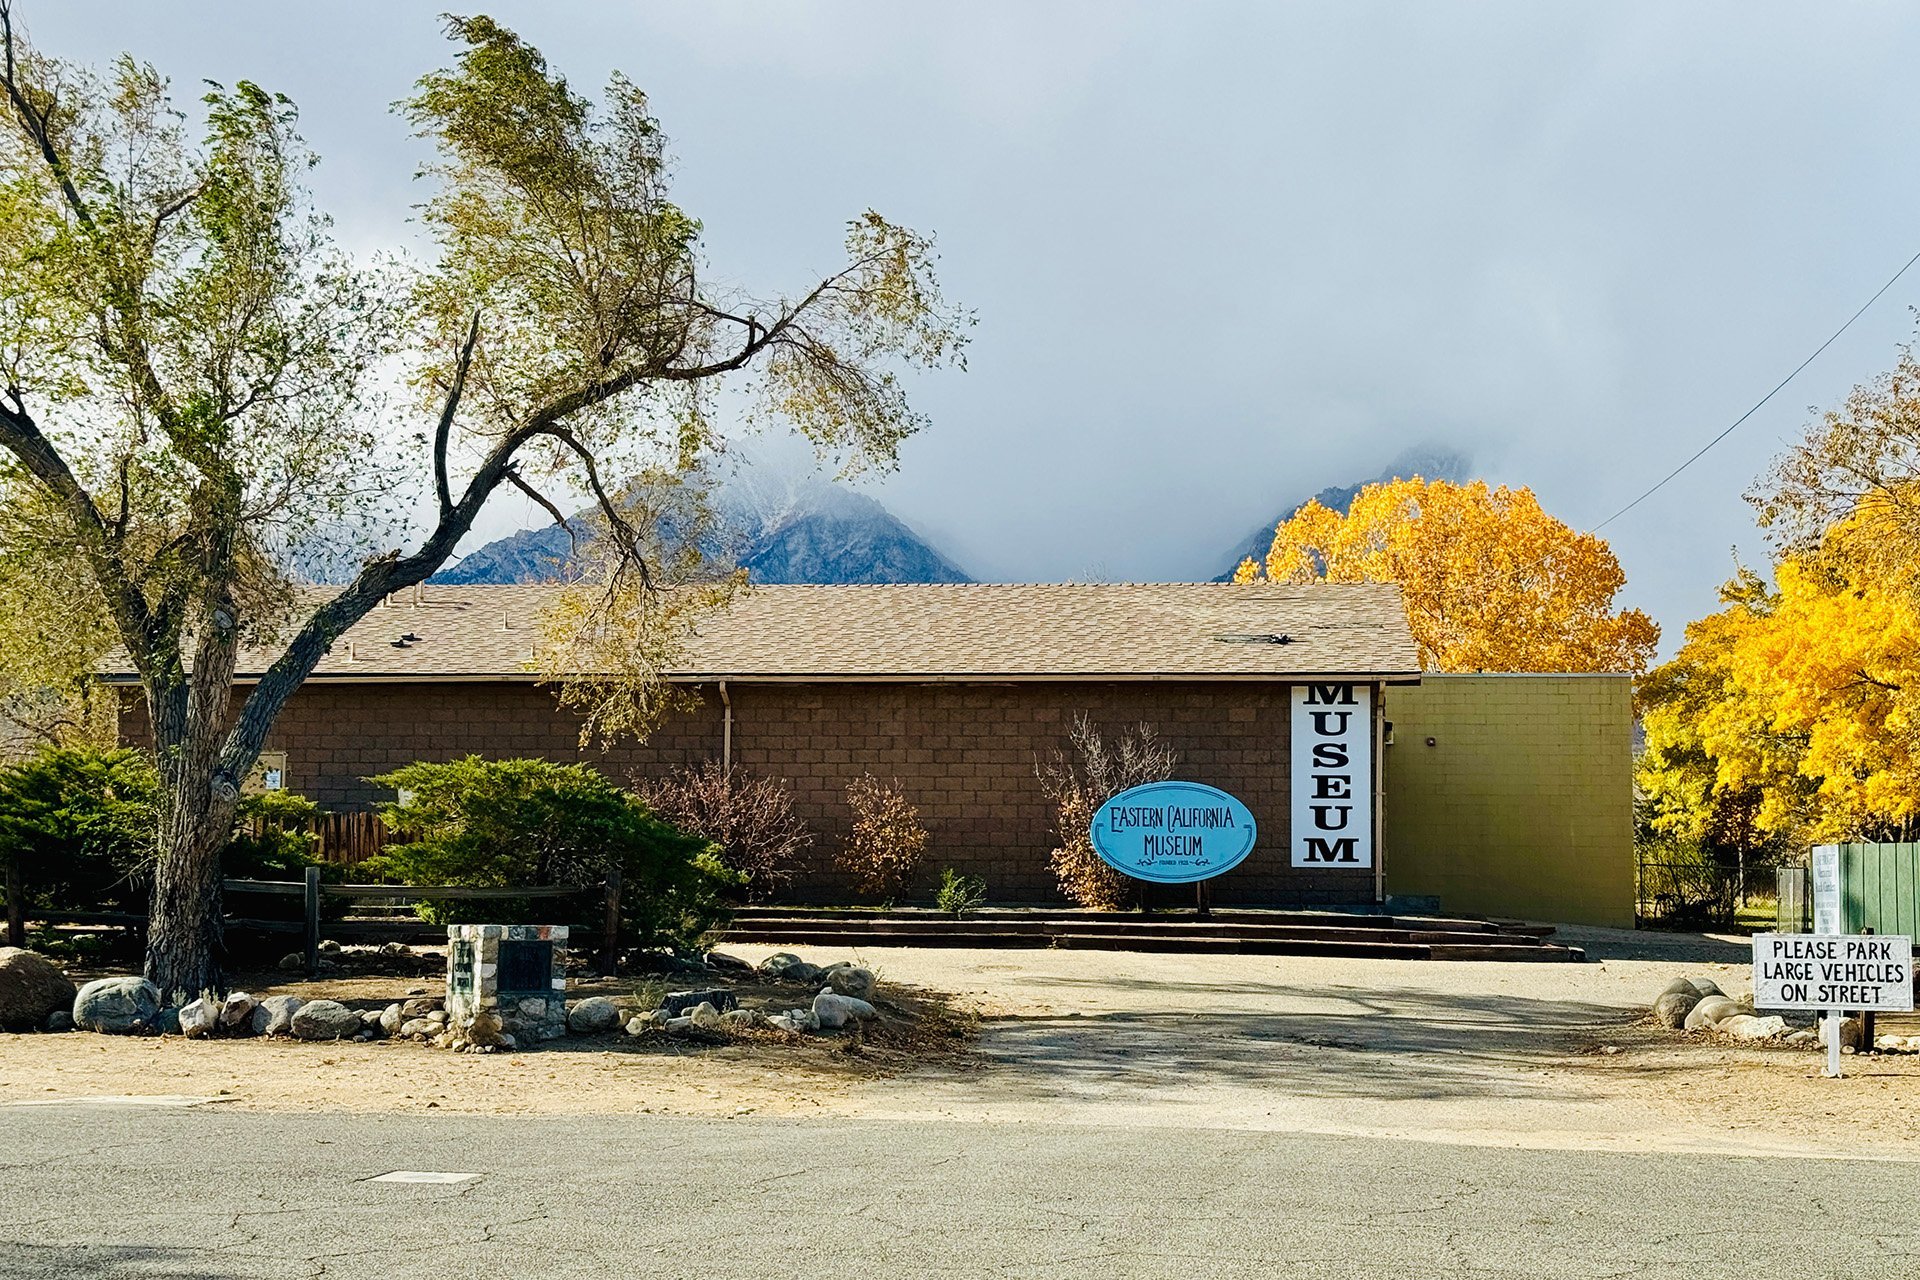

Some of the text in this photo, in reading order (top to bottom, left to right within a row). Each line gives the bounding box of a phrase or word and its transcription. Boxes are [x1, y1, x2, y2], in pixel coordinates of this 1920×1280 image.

[1302, 685, 1359, 862] MUSEUM
[1110, 805, 1235, 833] EASTERN CALIFORNIA
[1144, 835, 1203, 860] MUSEUM
[1773, 941, 1892, 961] PLEASE PARK
[1763, 962, 1904, 983] LARGE VEHICLES
[1781, 983, 1882, 1004] ON STREET
